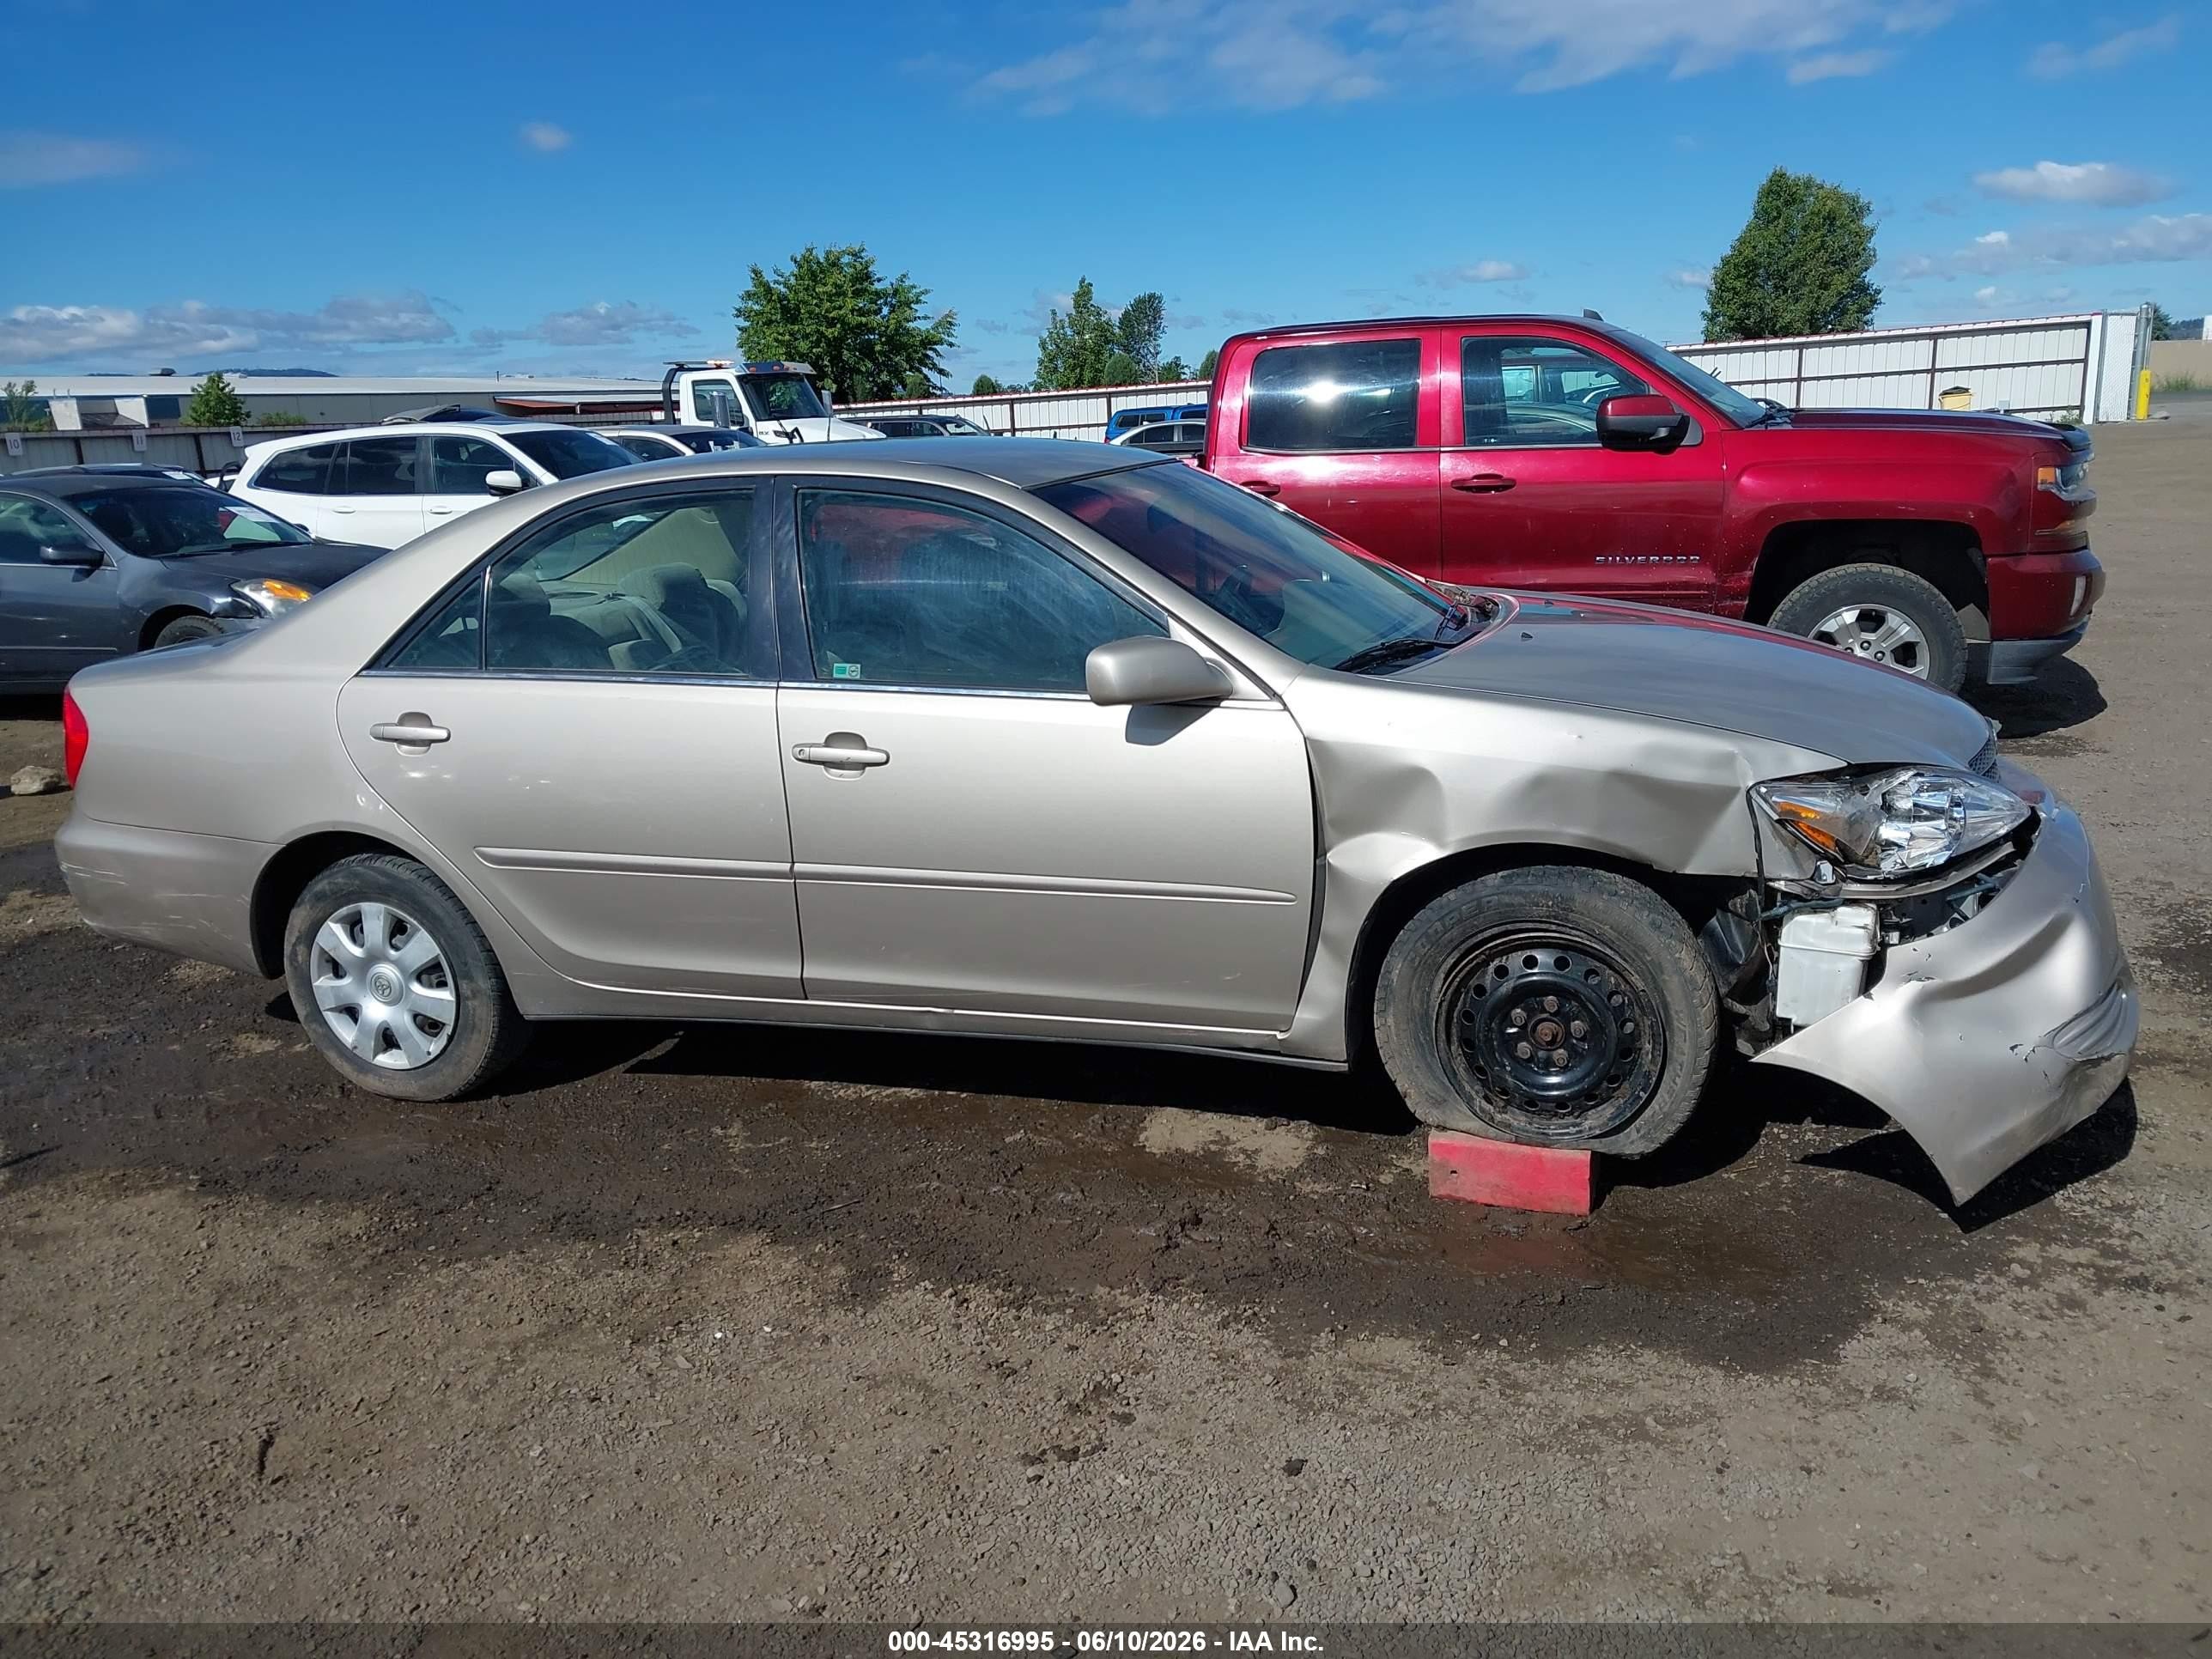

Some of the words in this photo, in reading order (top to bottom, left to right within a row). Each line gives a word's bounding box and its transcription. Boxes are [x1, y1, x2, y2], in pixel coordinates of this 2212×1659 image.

[136, 435, 143, 446] 11
[232, 432, 241, 441] 12
[9, 439, 20, 450] 10
[1595, 556, 1700, 564] SILVERADO
